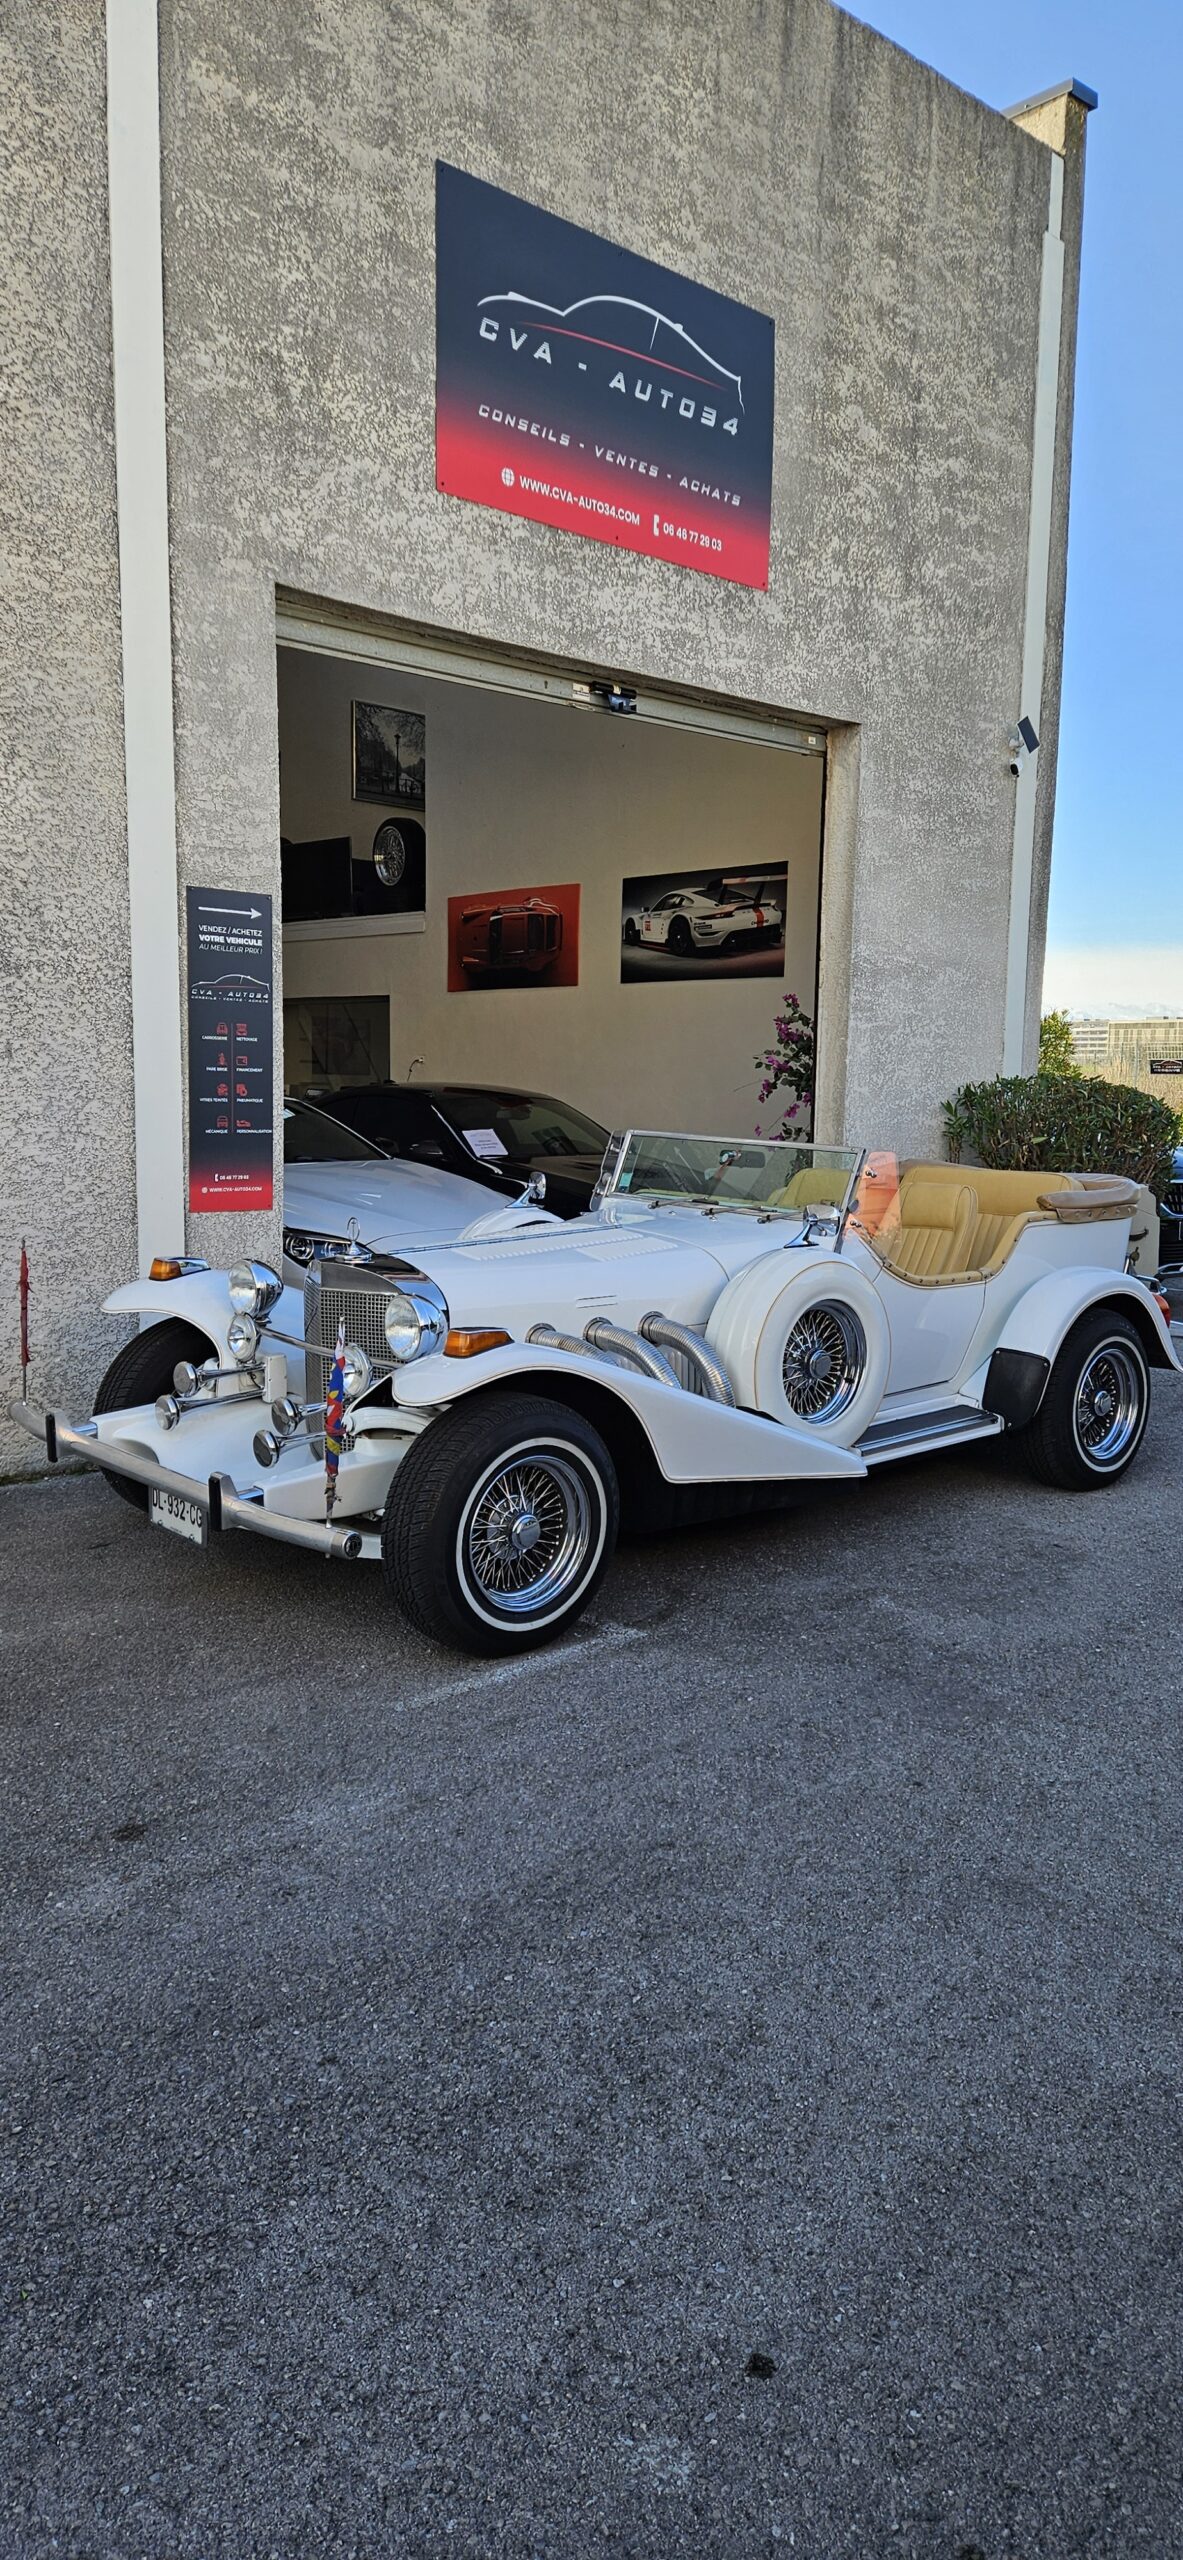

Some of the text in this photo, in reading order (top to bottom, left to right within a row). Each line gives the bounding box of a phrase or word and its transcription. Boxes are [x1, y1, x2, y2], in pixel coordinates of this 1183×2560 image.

[479, 317, 552, 364] CVA
[608, 371, 739, 436] AUTO34
[478, 404, 571, 447] CONSEILS
[594, 444, 659, 478] VENTES
[679, 476, 741, 507] ACHATS
[519, 475, 641, 526] WWW.CVA-AUTO34.COM
[663, 522, 722, 552] 06 46 77 29 03
[198, 924, 227, 934] VENDEZ
[231, 928, 263, 937] ACHETEZ
[198, 934, 263, 946] VOTRE VEHICULE
[210, 944, 244, 953] MEILLEUR
[244, 946, 260, 954] PRIX
[191, 988, 213, 996] CVA
[227, 991, 269, 999] AUTO34
